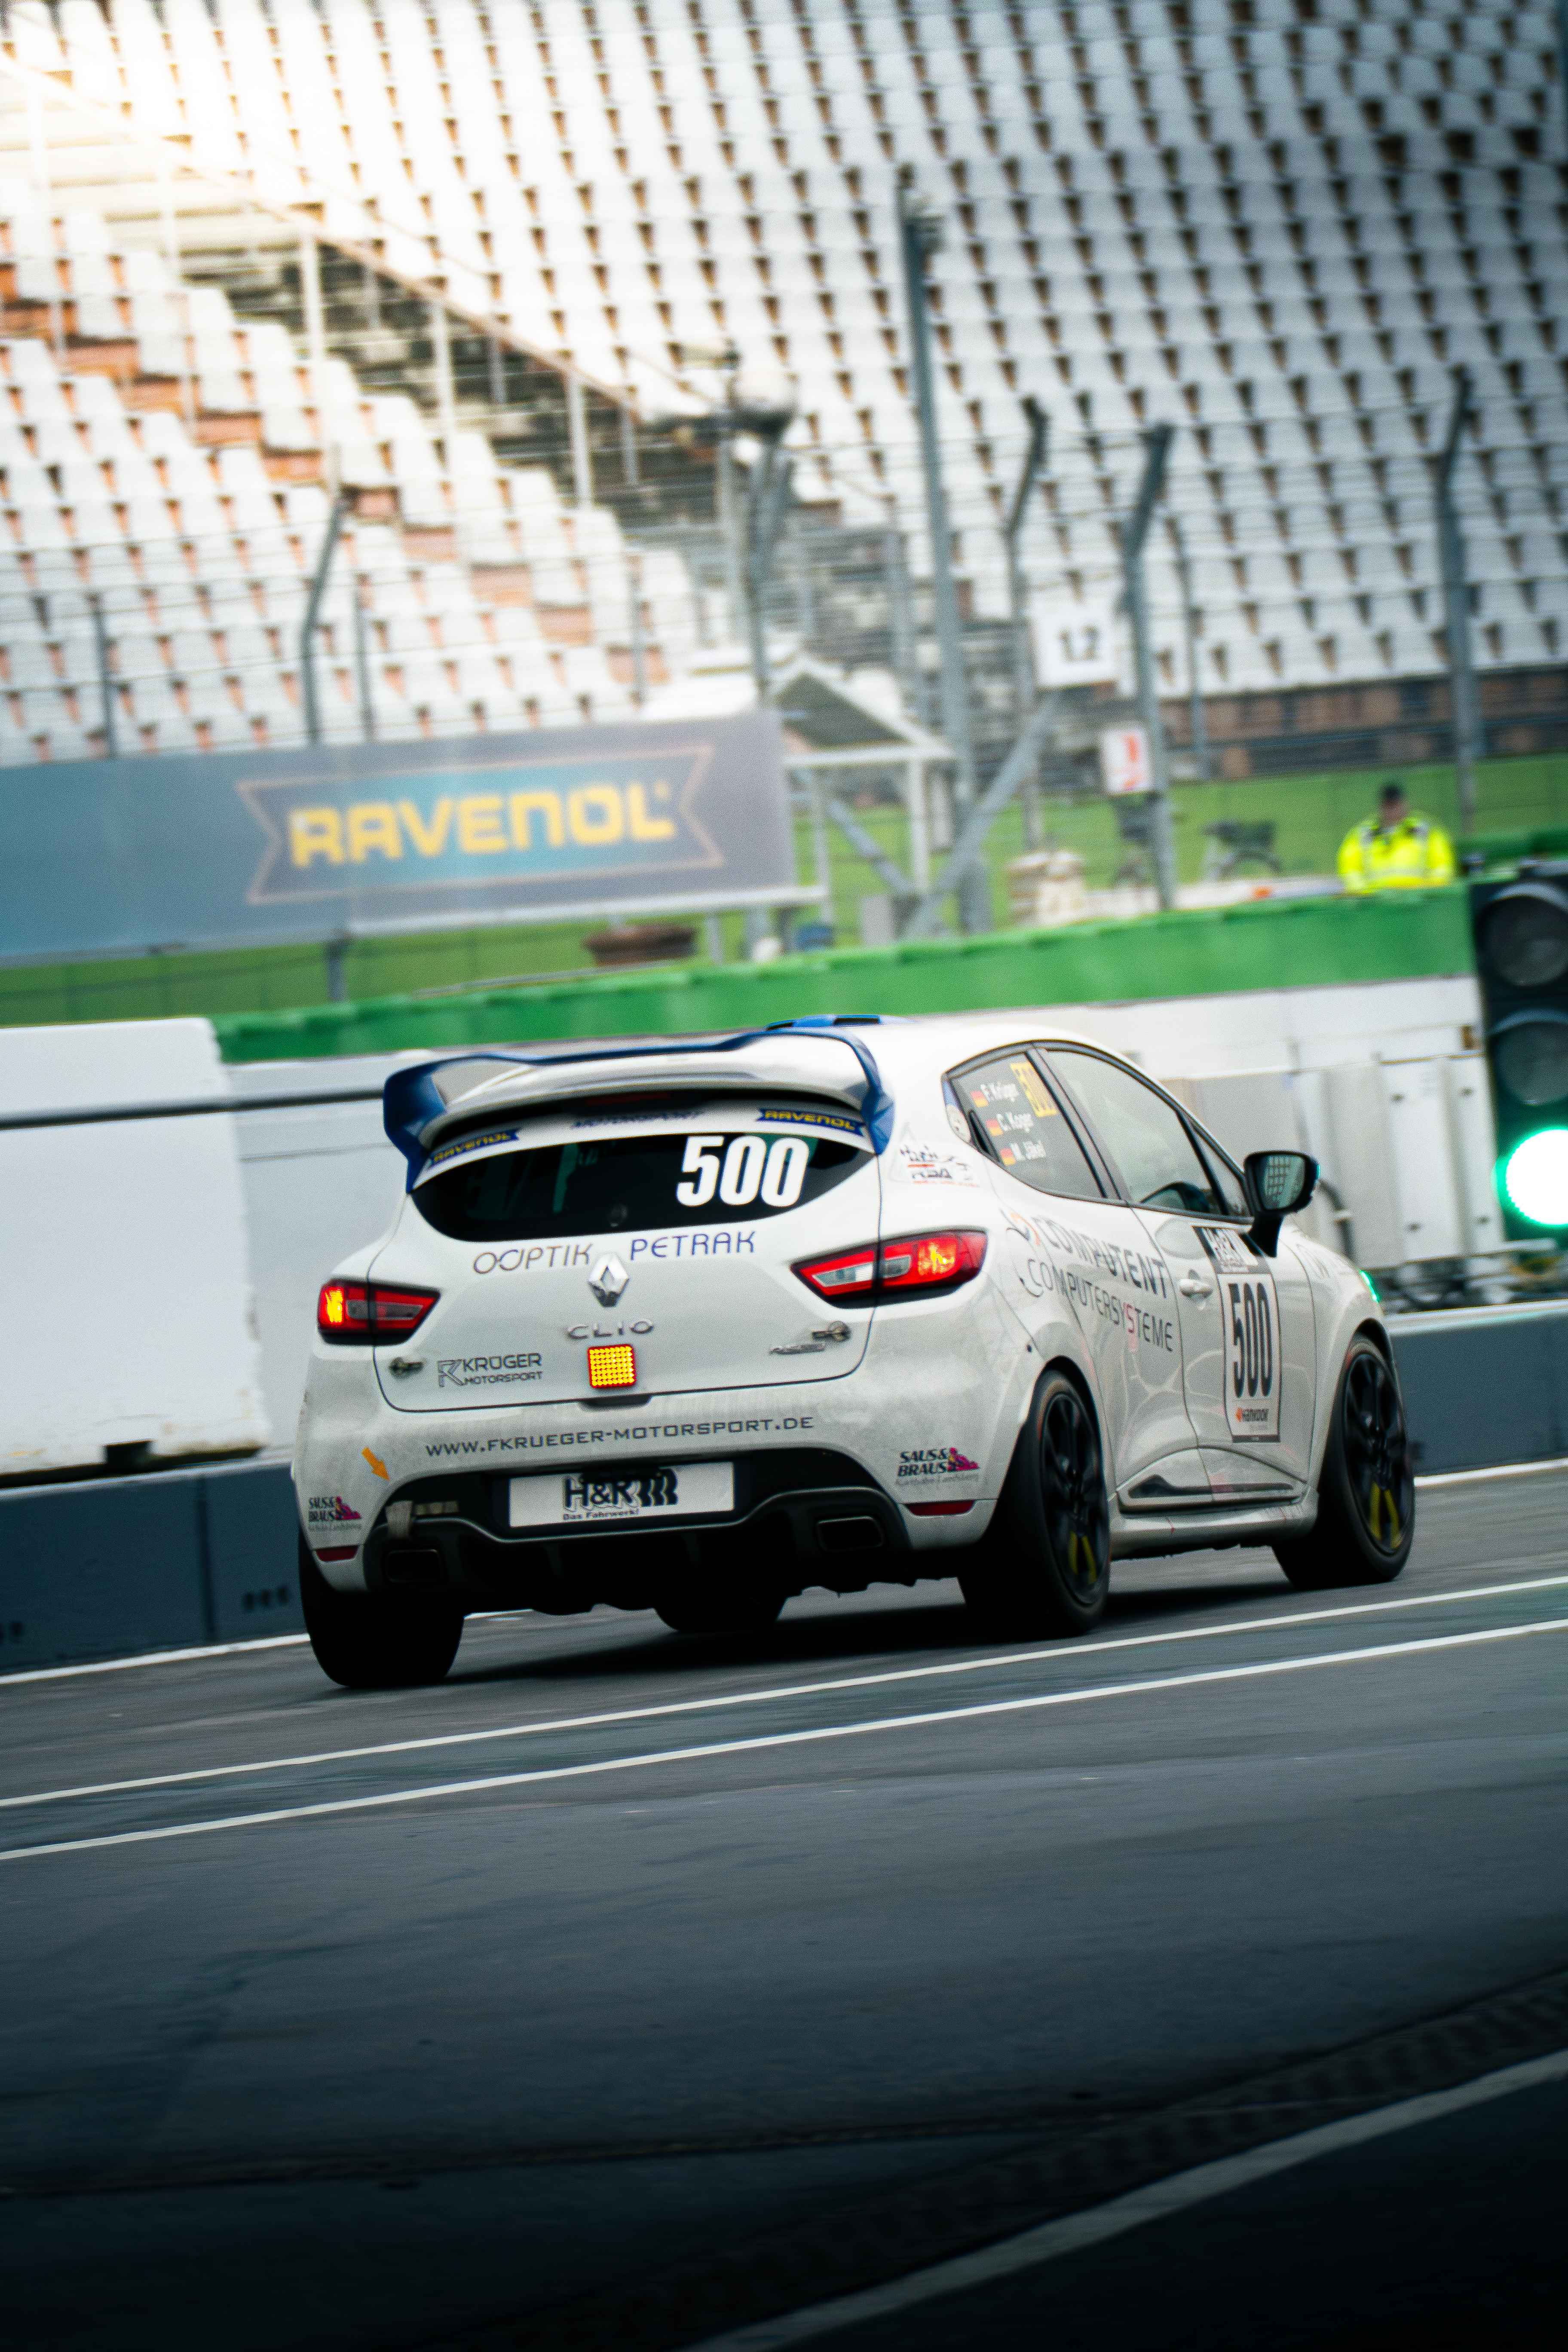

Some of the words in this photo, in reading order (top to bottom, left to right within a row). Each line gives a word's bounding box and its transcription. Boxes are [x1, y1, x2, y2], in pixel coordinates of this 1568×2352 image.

[288, 783, 675, 868] RAVENOL
[765, 1110, 856, 1130] RAVENOL
[676, 1135, 810, 1207] 500
[630, 1230, 756, 1261] PETRAK
[564, 1319, 655, 1340] CLIO
[1228, 1282, 1272, 1397] 500
[465, 1371, 543, 1384] MOTORSPORT
[425, 1417, 815, 1458] WWW.FKRUEGER-MOTORSPORT.DE
[897, 1461, 948, 1477] BRAUS
[564, 1476, 642, 1509] H&R
